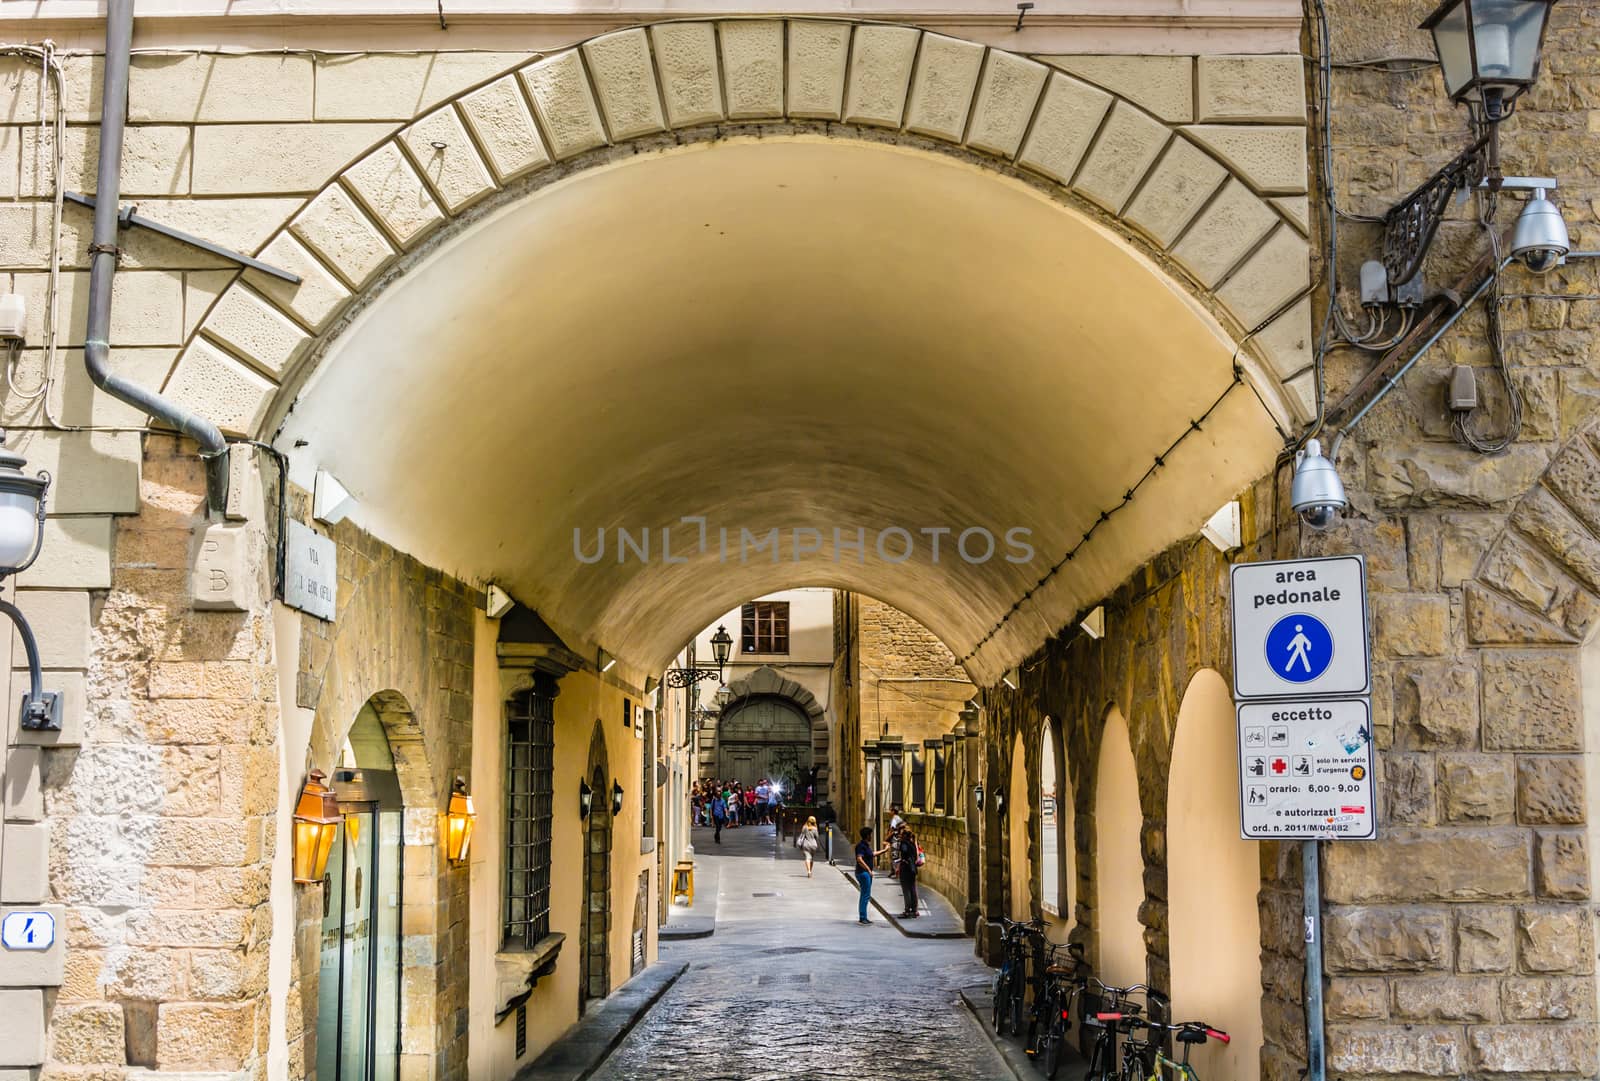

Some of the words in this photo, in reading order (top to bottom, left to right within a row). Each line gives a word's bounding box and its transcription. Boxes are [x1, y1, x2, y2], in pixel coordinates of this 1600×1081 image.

[1275, 569, 1317, 584] area
[1253, 586, 1341, 609] pedonale
[1271, 707, 1333, 722] eccetto
[1340, 756, 1367, 764] servizio
[1269, 784, 1301, 793] orario:
[1308, 783, 1330, 793] 6.00
[1337, 783, 1360, 793] 9.00
[1275, 809, 1282, 817] e
[1284, 807, 1337, 817] autorizzati
[1252, 823, 1271, 832] ord.
[22, 917, 38, 944] 4
